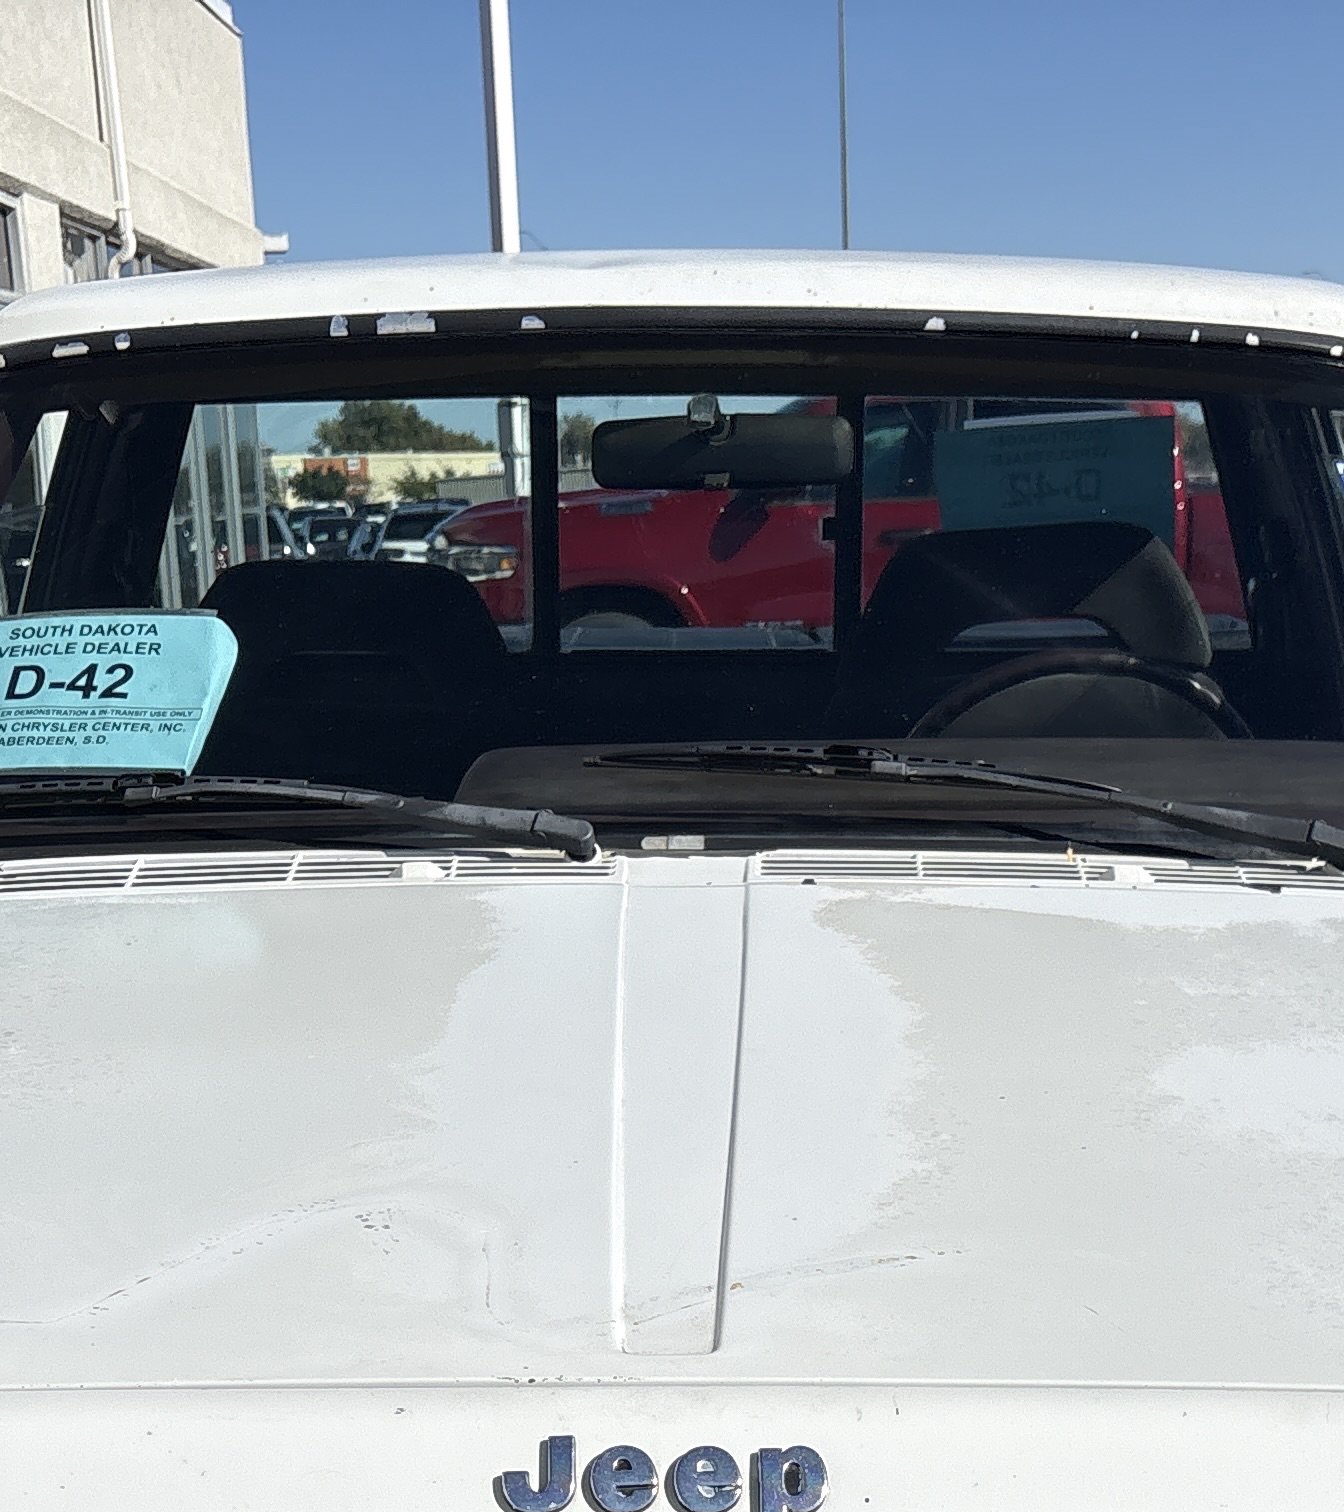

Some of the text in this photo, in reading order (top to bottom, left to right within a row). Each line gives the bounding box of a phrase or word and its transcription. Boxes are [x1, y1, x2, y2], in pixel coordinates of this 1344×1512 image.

[9, 623, 159, 640] SOUTH DAKOTA
[82, 641, 162, 656] DEALER
[4, 663, 134, 700] D-42
[14, 708, 89, 717] DEMONSTRATION
[98, 709, 148, 717] IN-TRANSIT
[11, 721, 88, 733] CHRYSLER
[92, 721, 154, 734] CENTER,
[158, 722, 186, 733] INC.
[82, 734, 110, 746] S.D.
